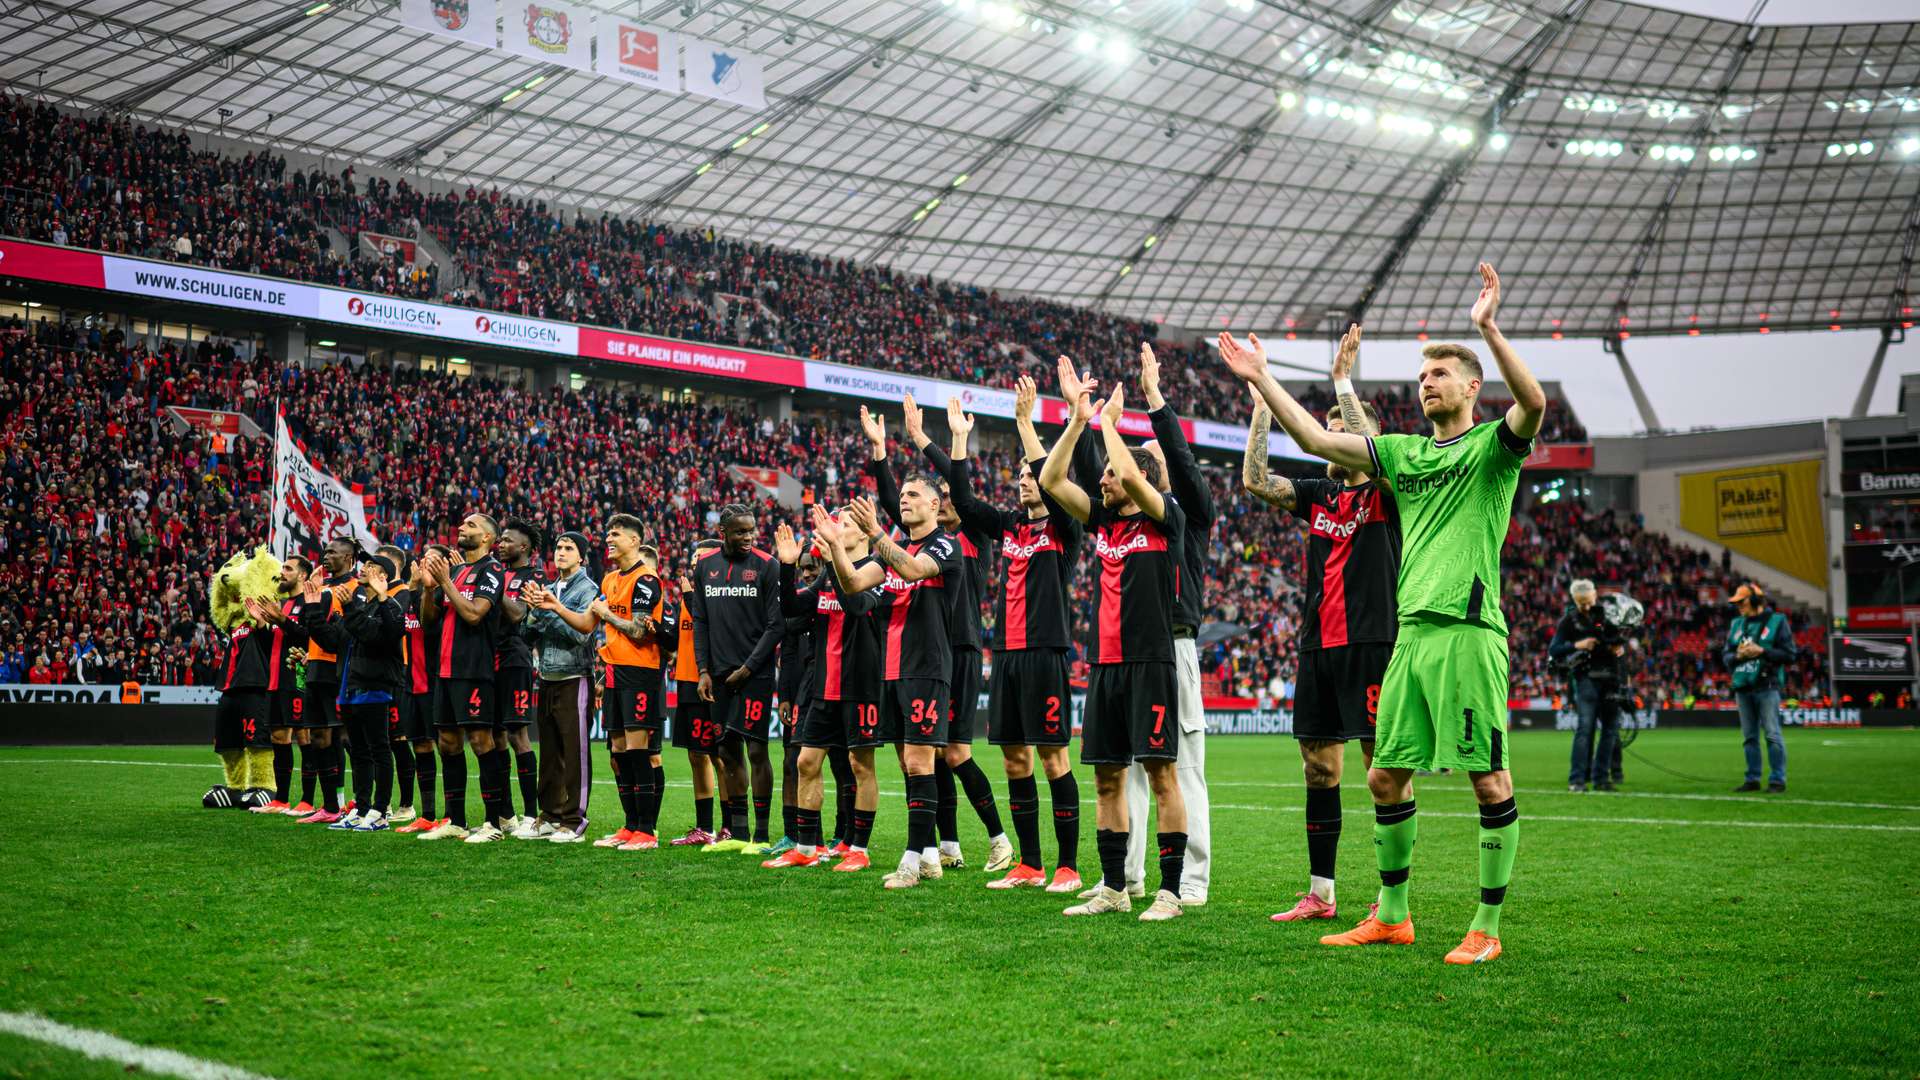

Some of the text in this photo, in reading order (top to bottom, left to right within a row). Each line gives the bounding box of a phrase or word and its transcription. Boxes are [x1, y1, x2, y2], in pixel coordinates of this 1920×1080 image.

[135, 272, 286, 305] WWW.SCHULIGEN.DE
[607, 340, 746, 373] SIE PLANEN EIN PROJEKT?
[1860, 472, 1920, 490] Barme
[705, 584, 757, 597] Barmenia
[292, 698, 302, 713] 9
[468, 688, 480, 707] 4
[513, 690, 528, 708] 12
[635, 692, 647, 712] 3
[745, 697, 763, 721] 18
[1046, 696, 1060, 721] 2
[1366, 684, 1381, 714] 8
[857, 703, 878, 726] 10
[910, 698, 938, 724] 34
[1151, 704, 1165, 734] 7
[242, 718, 256, 733] 14
[691, 718, 713, 739] 32
[1463, 707, 1473, 741] 1
